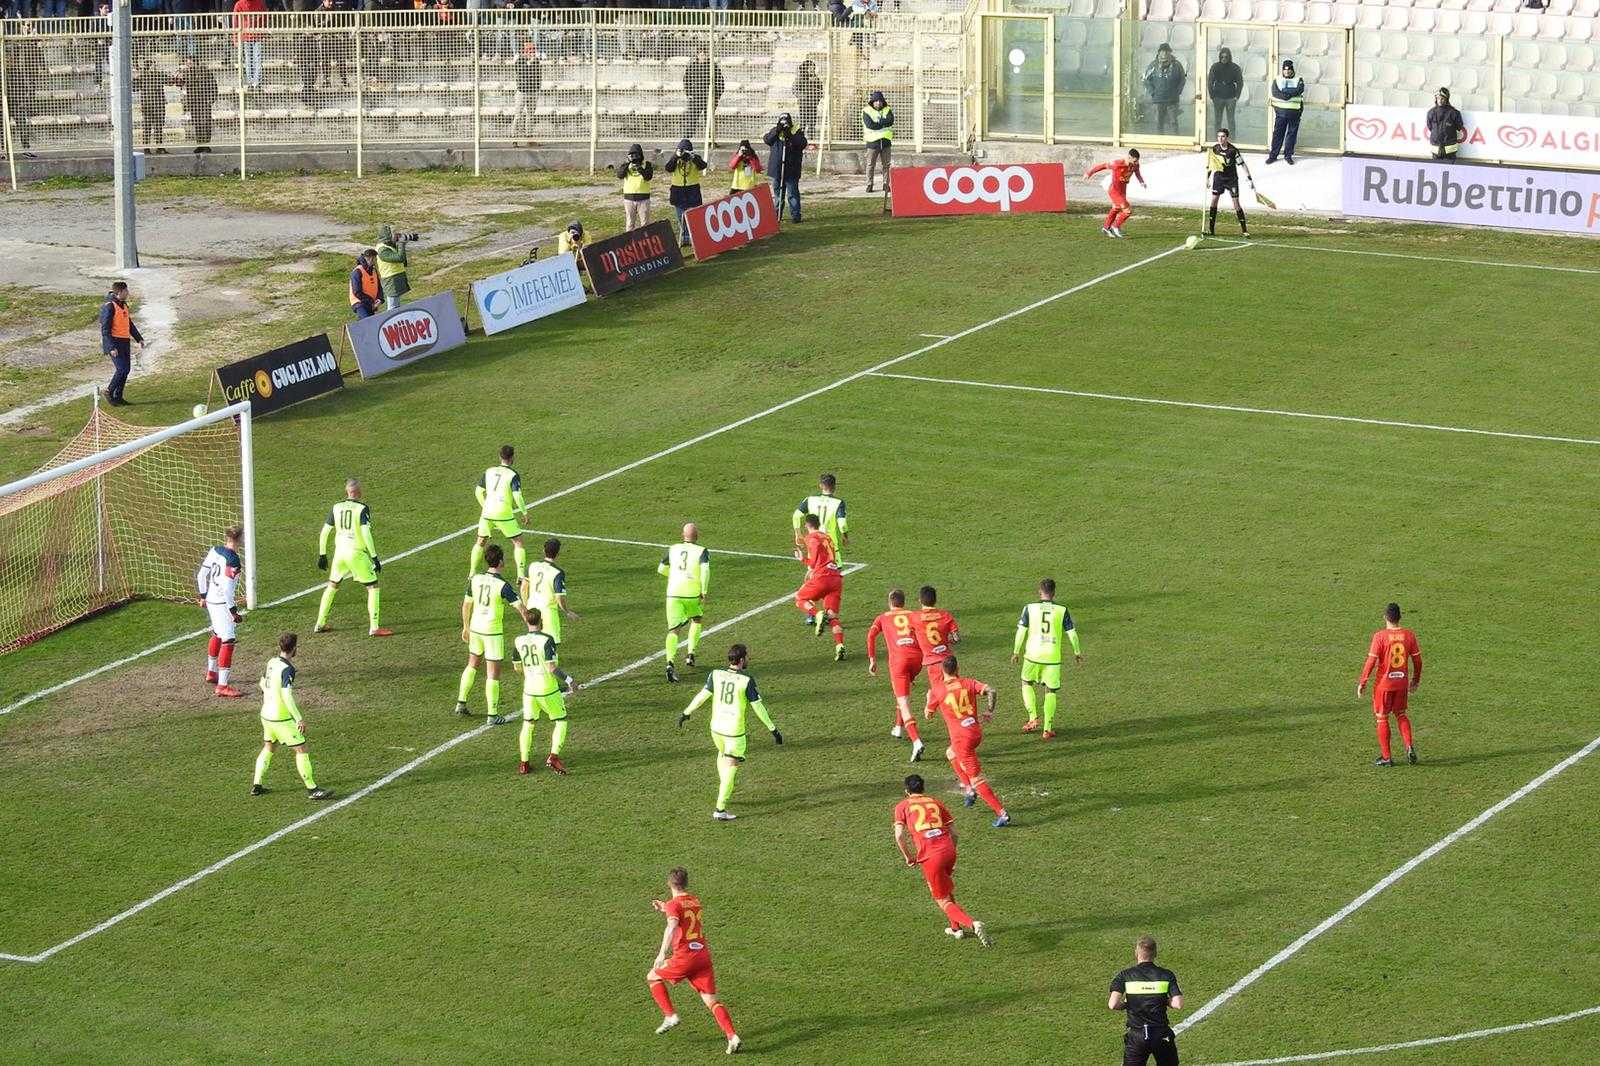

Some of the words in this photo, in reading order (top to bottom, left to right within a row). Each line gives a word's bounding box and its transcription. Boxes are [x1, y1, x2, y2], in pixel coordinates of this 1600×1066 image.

[923, 165, 1034, 212] coop
[704, 192, 760, 242] coop
[600, 231, 665, 274] mastria
[628, 256, 670, 277] VENDING
[382, 317, 432, 351] Wüber
[225, 378, 256, 402] Caffè
[271, 351, 337, 389] GUGLIELMO
[494, 473, 502, 491] 7
[339, 509, 353, 530] 10
[679, 550, 689, 571] 3
[535, 571, 544, 593] 2
[478, 583, 492, 607] 13
[893, 614, 911, 636] 9
[925, 621, 942, 646] 6
[1041, 611, 1051, 634] 5
[520, 644, 540, 667] 26
[1390, 642, 1405, 669] 8
[720, 680, 735, 705] 18
[943, 688, 974, 719] 14
[909, 803, 943, 832] 23
